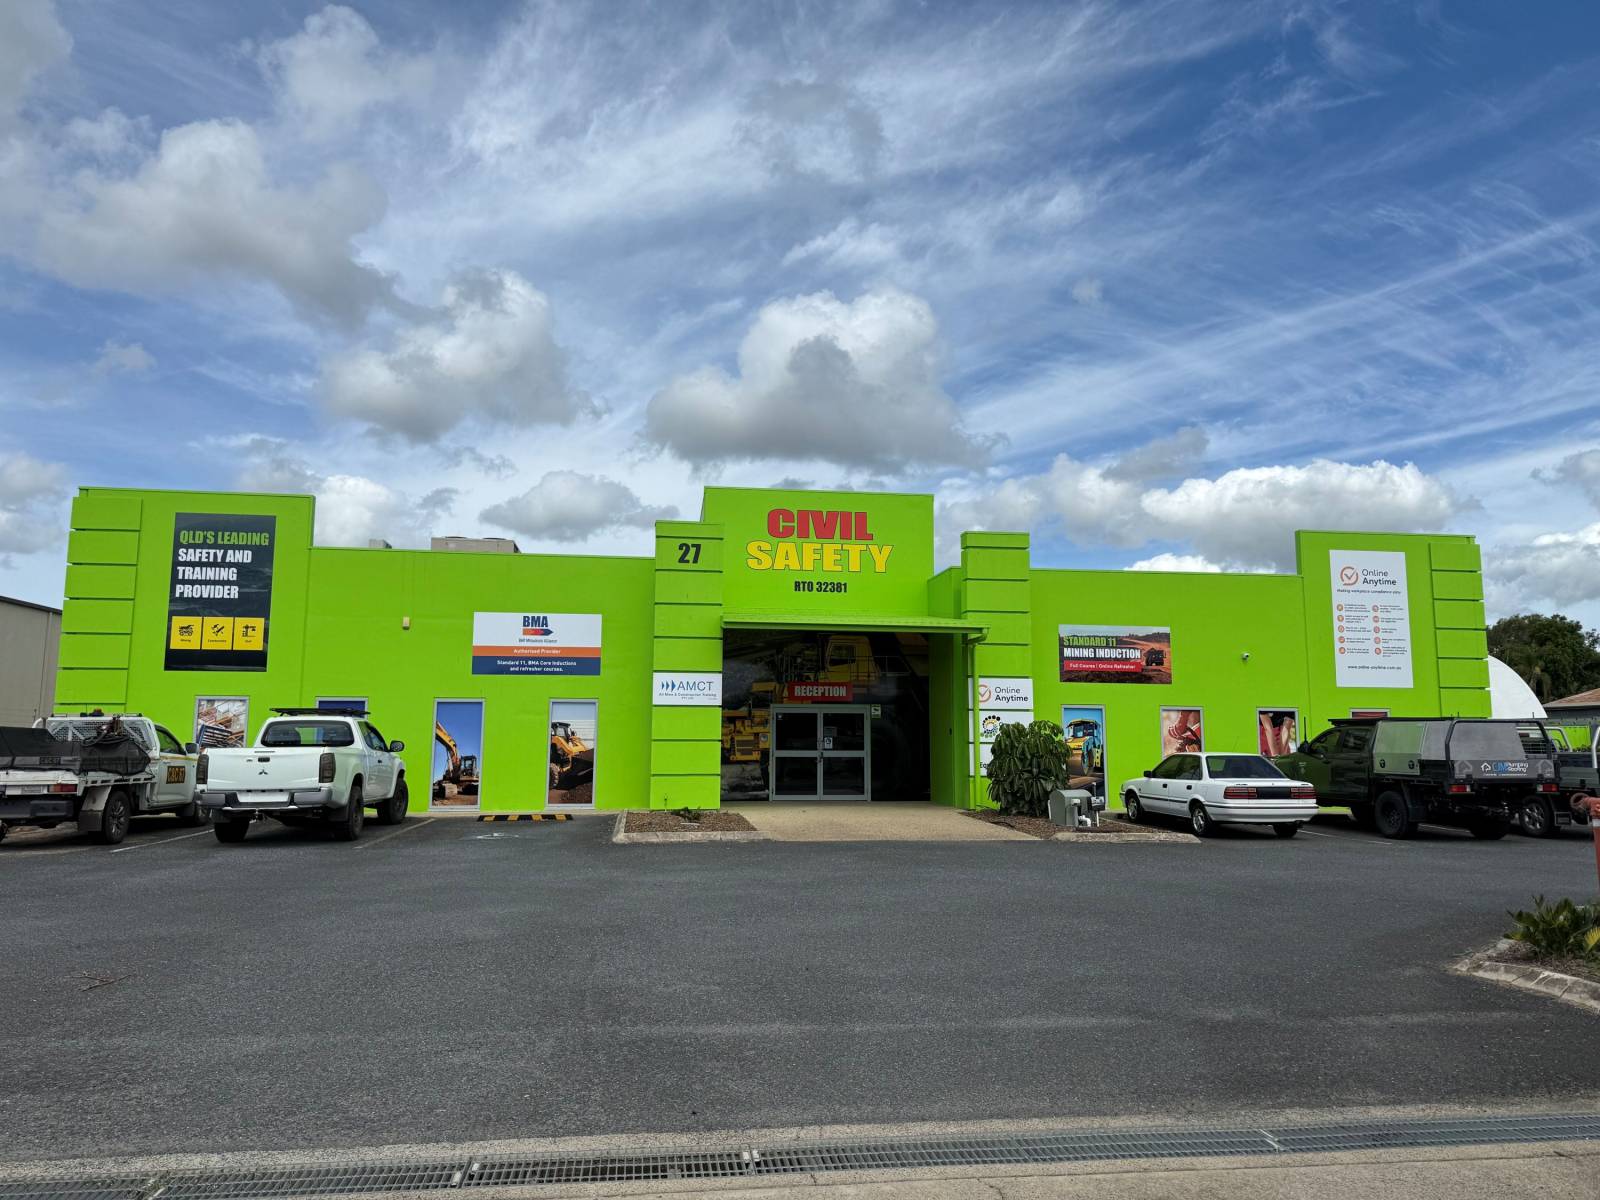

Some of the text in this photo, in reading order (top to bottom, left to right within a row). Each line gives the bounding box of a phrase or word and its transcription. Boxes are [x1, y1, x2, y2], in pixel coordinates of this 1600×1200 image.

[767, 508, 873, 541] CIVIL
[180, 530, 269, 545] QLD'S LEADING
[178, 548, 252, 563] SAFETY AND
[678, 542, 702, 564] 27
[746, 540, 894, 573] SAFETY
[177, 566, 237, 580] TRAINING
[1361, 568, 1388, 577] Online
[794, 581, 847, 593] RTO 32381
[1362, 577, 1397, 587] Anytime
[175, 584, 239, 599] PROVIDER
[522, 615, 548, 627] BMA
[1063, 635, 1116, 646] STANDARD 11
[1063, 647, 1141, 659] MINING INDUCTION
[677, 681, 714, 691] AMCT
[794, 685, 847, 697] RECEPTION
[994, 686, 1021, 694] Online
[994, 694, 1029, 703] Anytime
